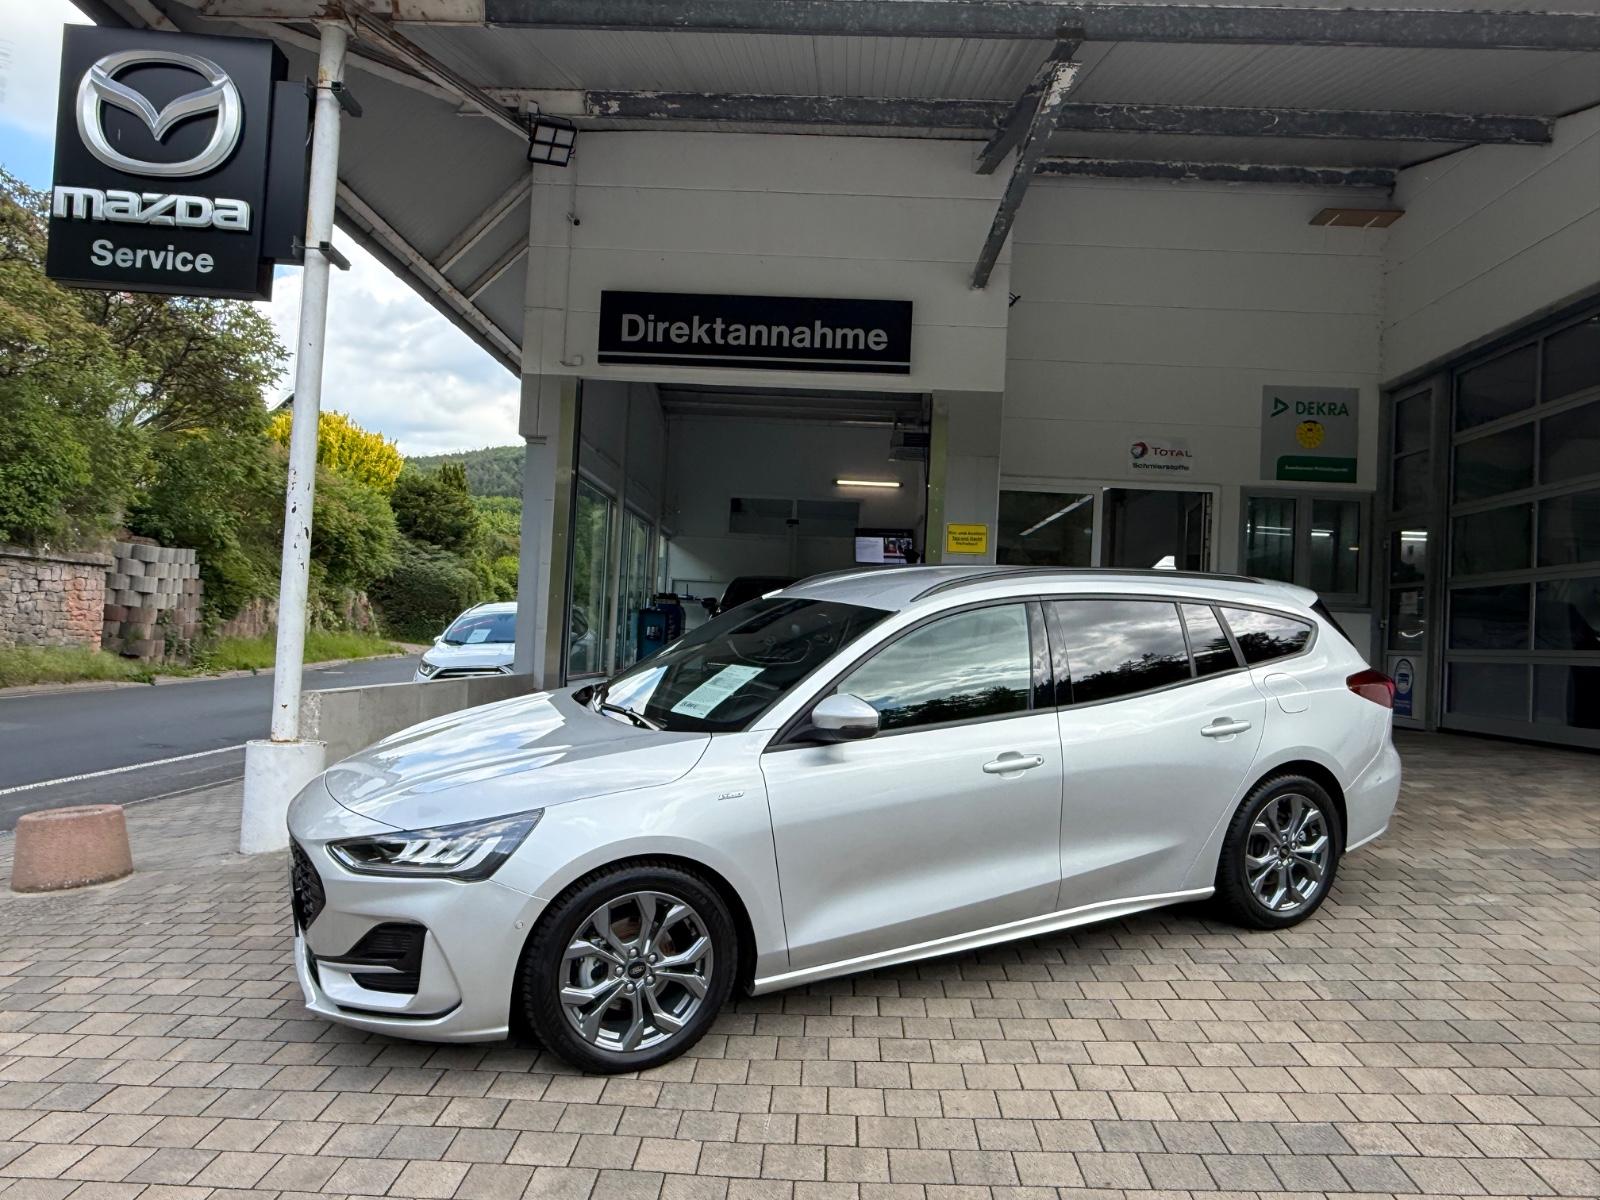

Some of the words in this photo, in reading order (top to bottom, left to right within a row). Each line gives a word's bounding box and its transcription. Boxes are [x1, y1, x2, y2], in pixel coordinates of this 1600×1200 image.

[90, 239, 215, 273] Service
[620, 313, 889, 351] Direktannahme
[1295, 401, 1349, 416] DEKRA
[1132, 462, 1190, 471] Schmierstoffe
